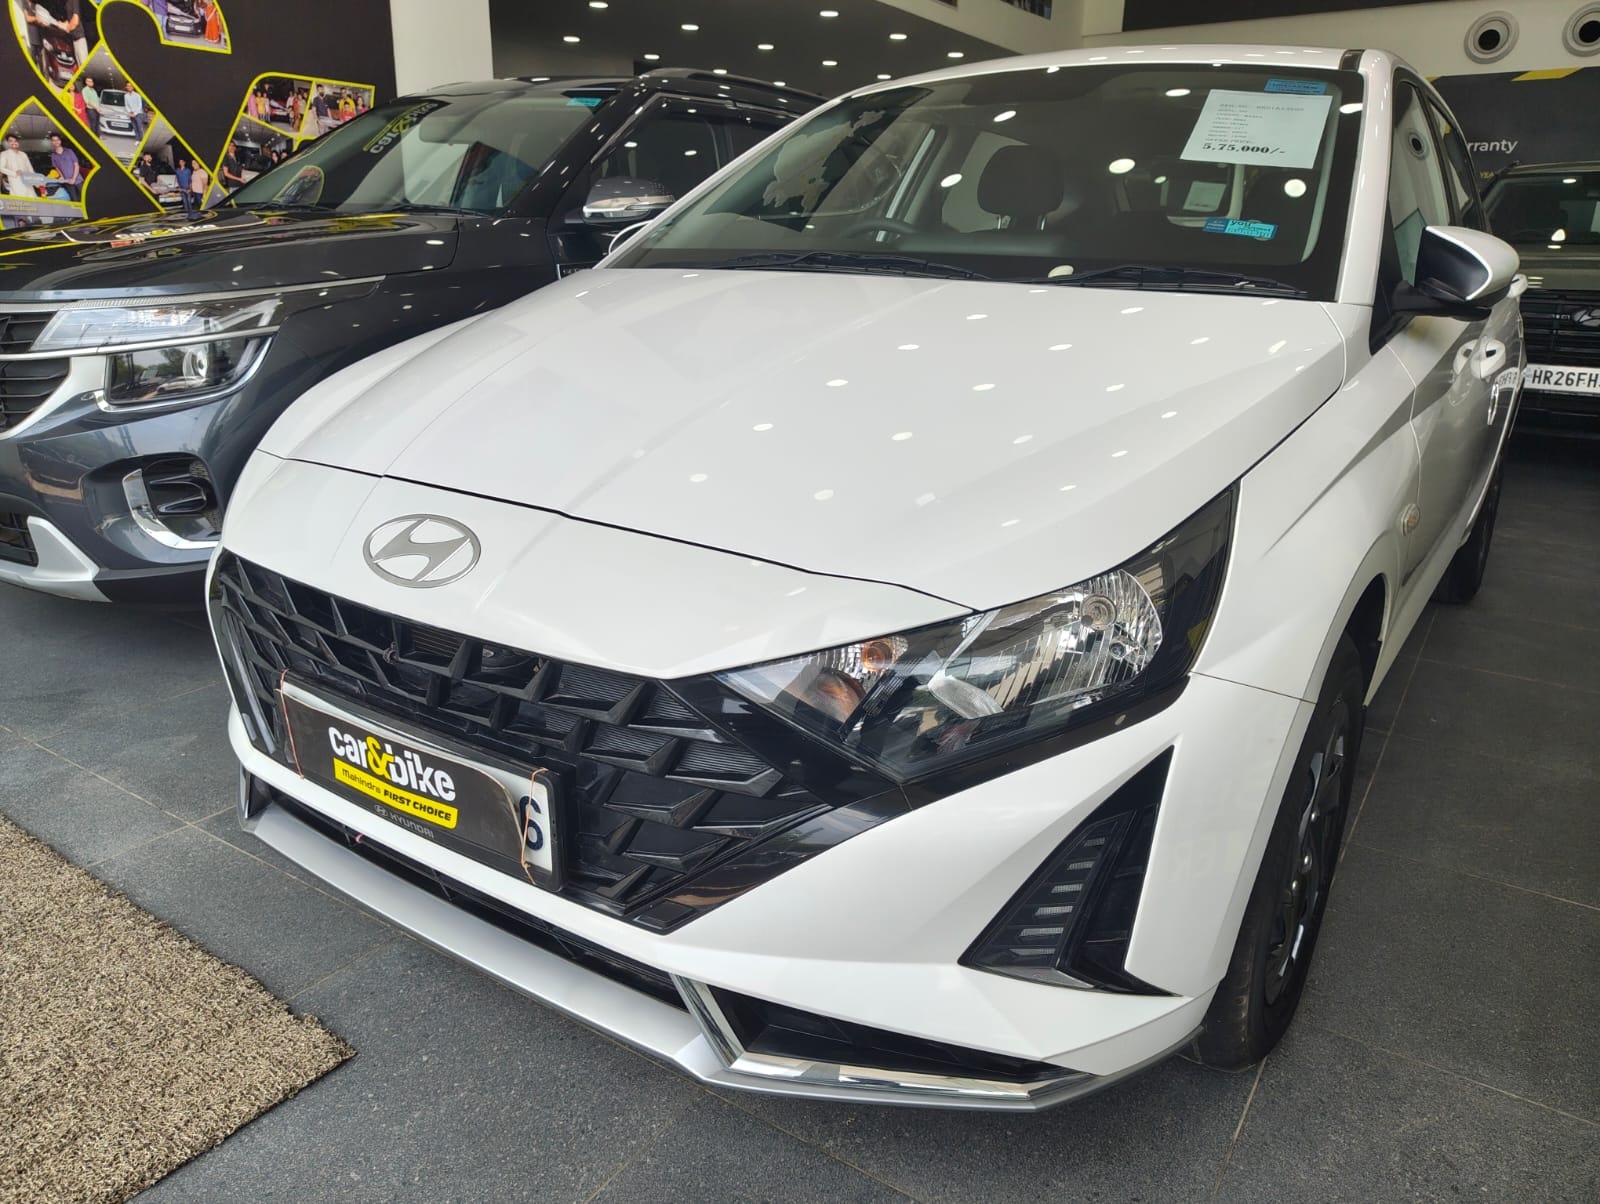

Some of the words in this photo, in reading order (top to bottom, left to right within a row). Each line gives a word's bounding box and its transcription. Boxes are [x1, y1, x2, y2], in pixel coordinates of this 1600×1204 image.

[1467, 139, 1519, 154] rranty
[1531, 368, 1600, 389] HR26FH
[328, 725, 457, 802] car&bike
[383, 789, 412, 807] FIRST
[411, 801, 452, 821] CHOICE
[389, 811, 434, 839] HYUNDAI
[518, 795, 544, 852] 6
